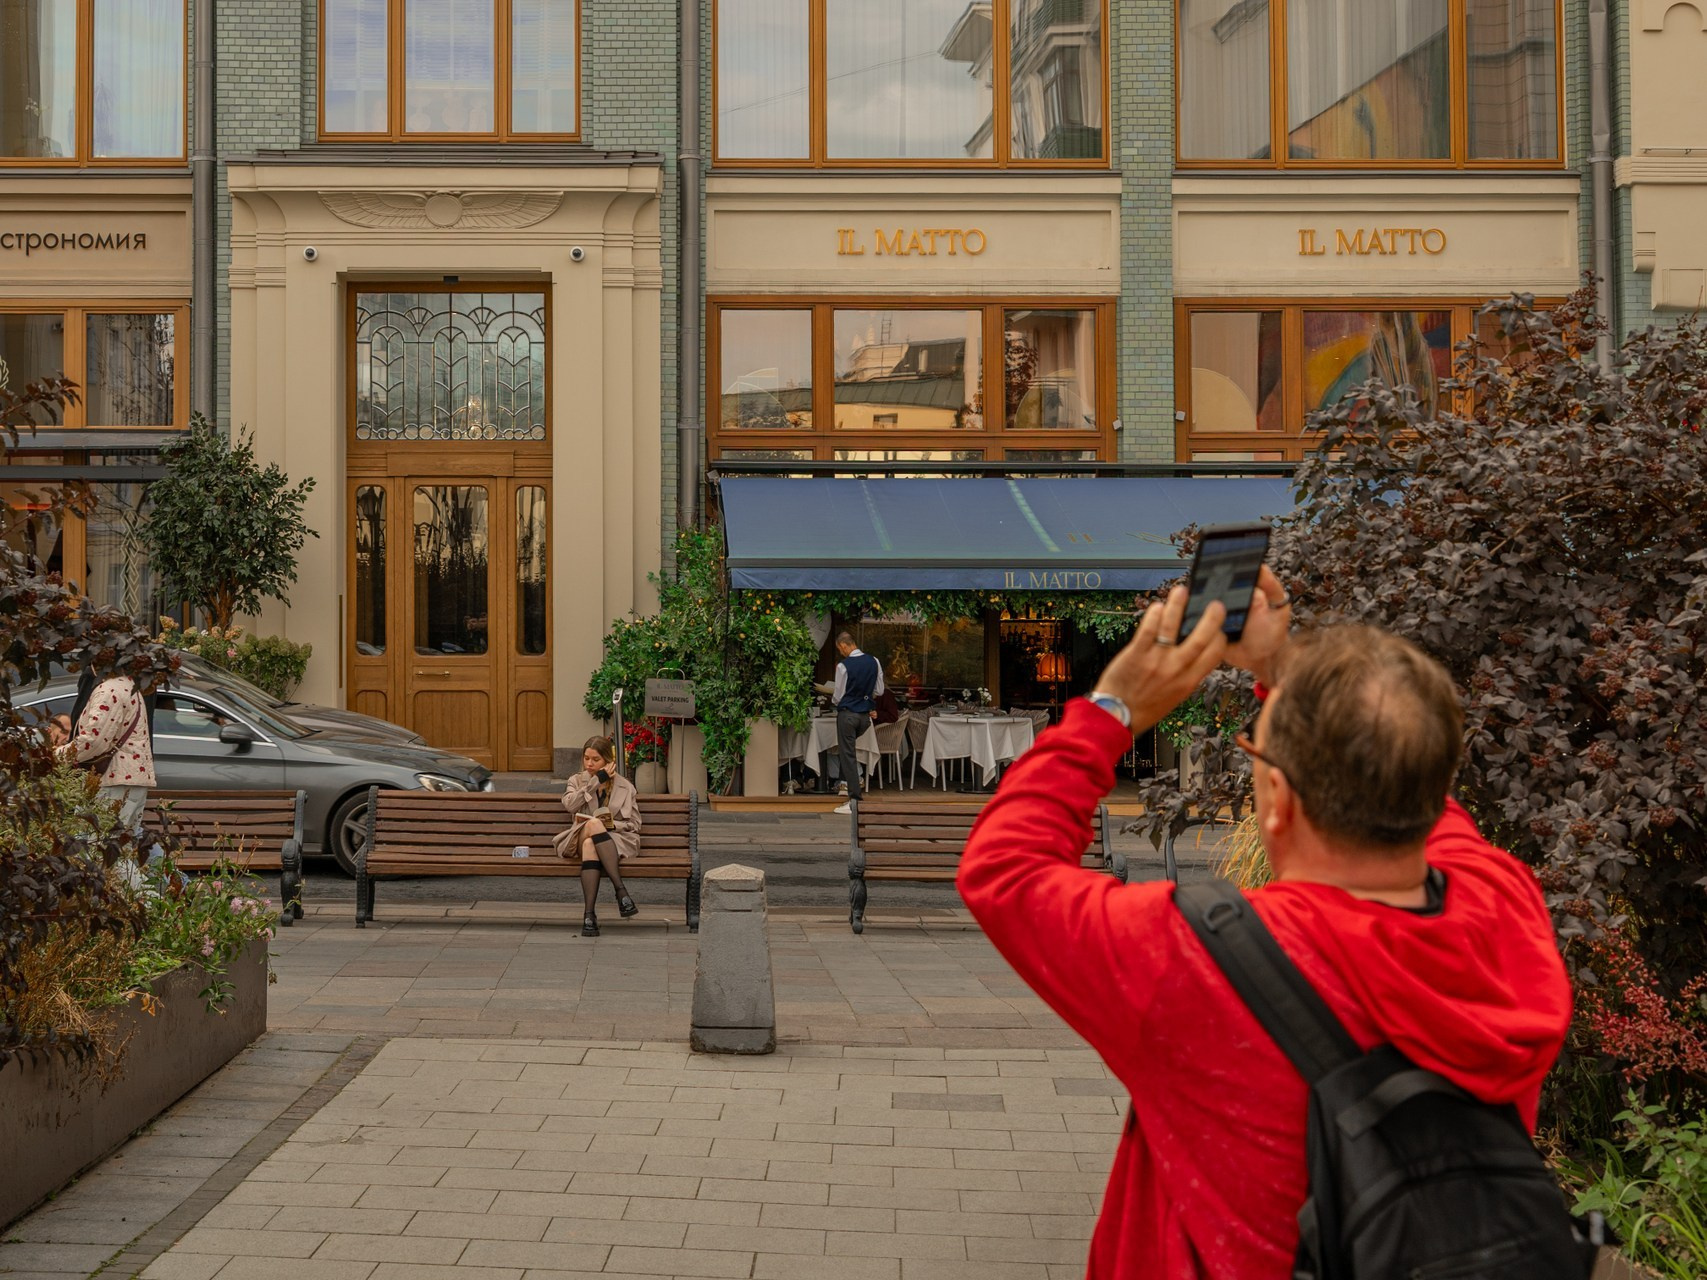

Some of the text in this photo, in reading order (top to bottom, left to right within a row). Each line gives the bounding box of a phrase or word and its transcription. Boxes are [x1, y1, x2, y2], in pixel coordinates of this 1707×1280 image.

[0, 232, 147, 257] строномия
[837, 228, 987, 256] IL MATTO
[1298, 227, 1447, 256] IL MATTO
[1004, 571, 1102, 589] IL MATTO
